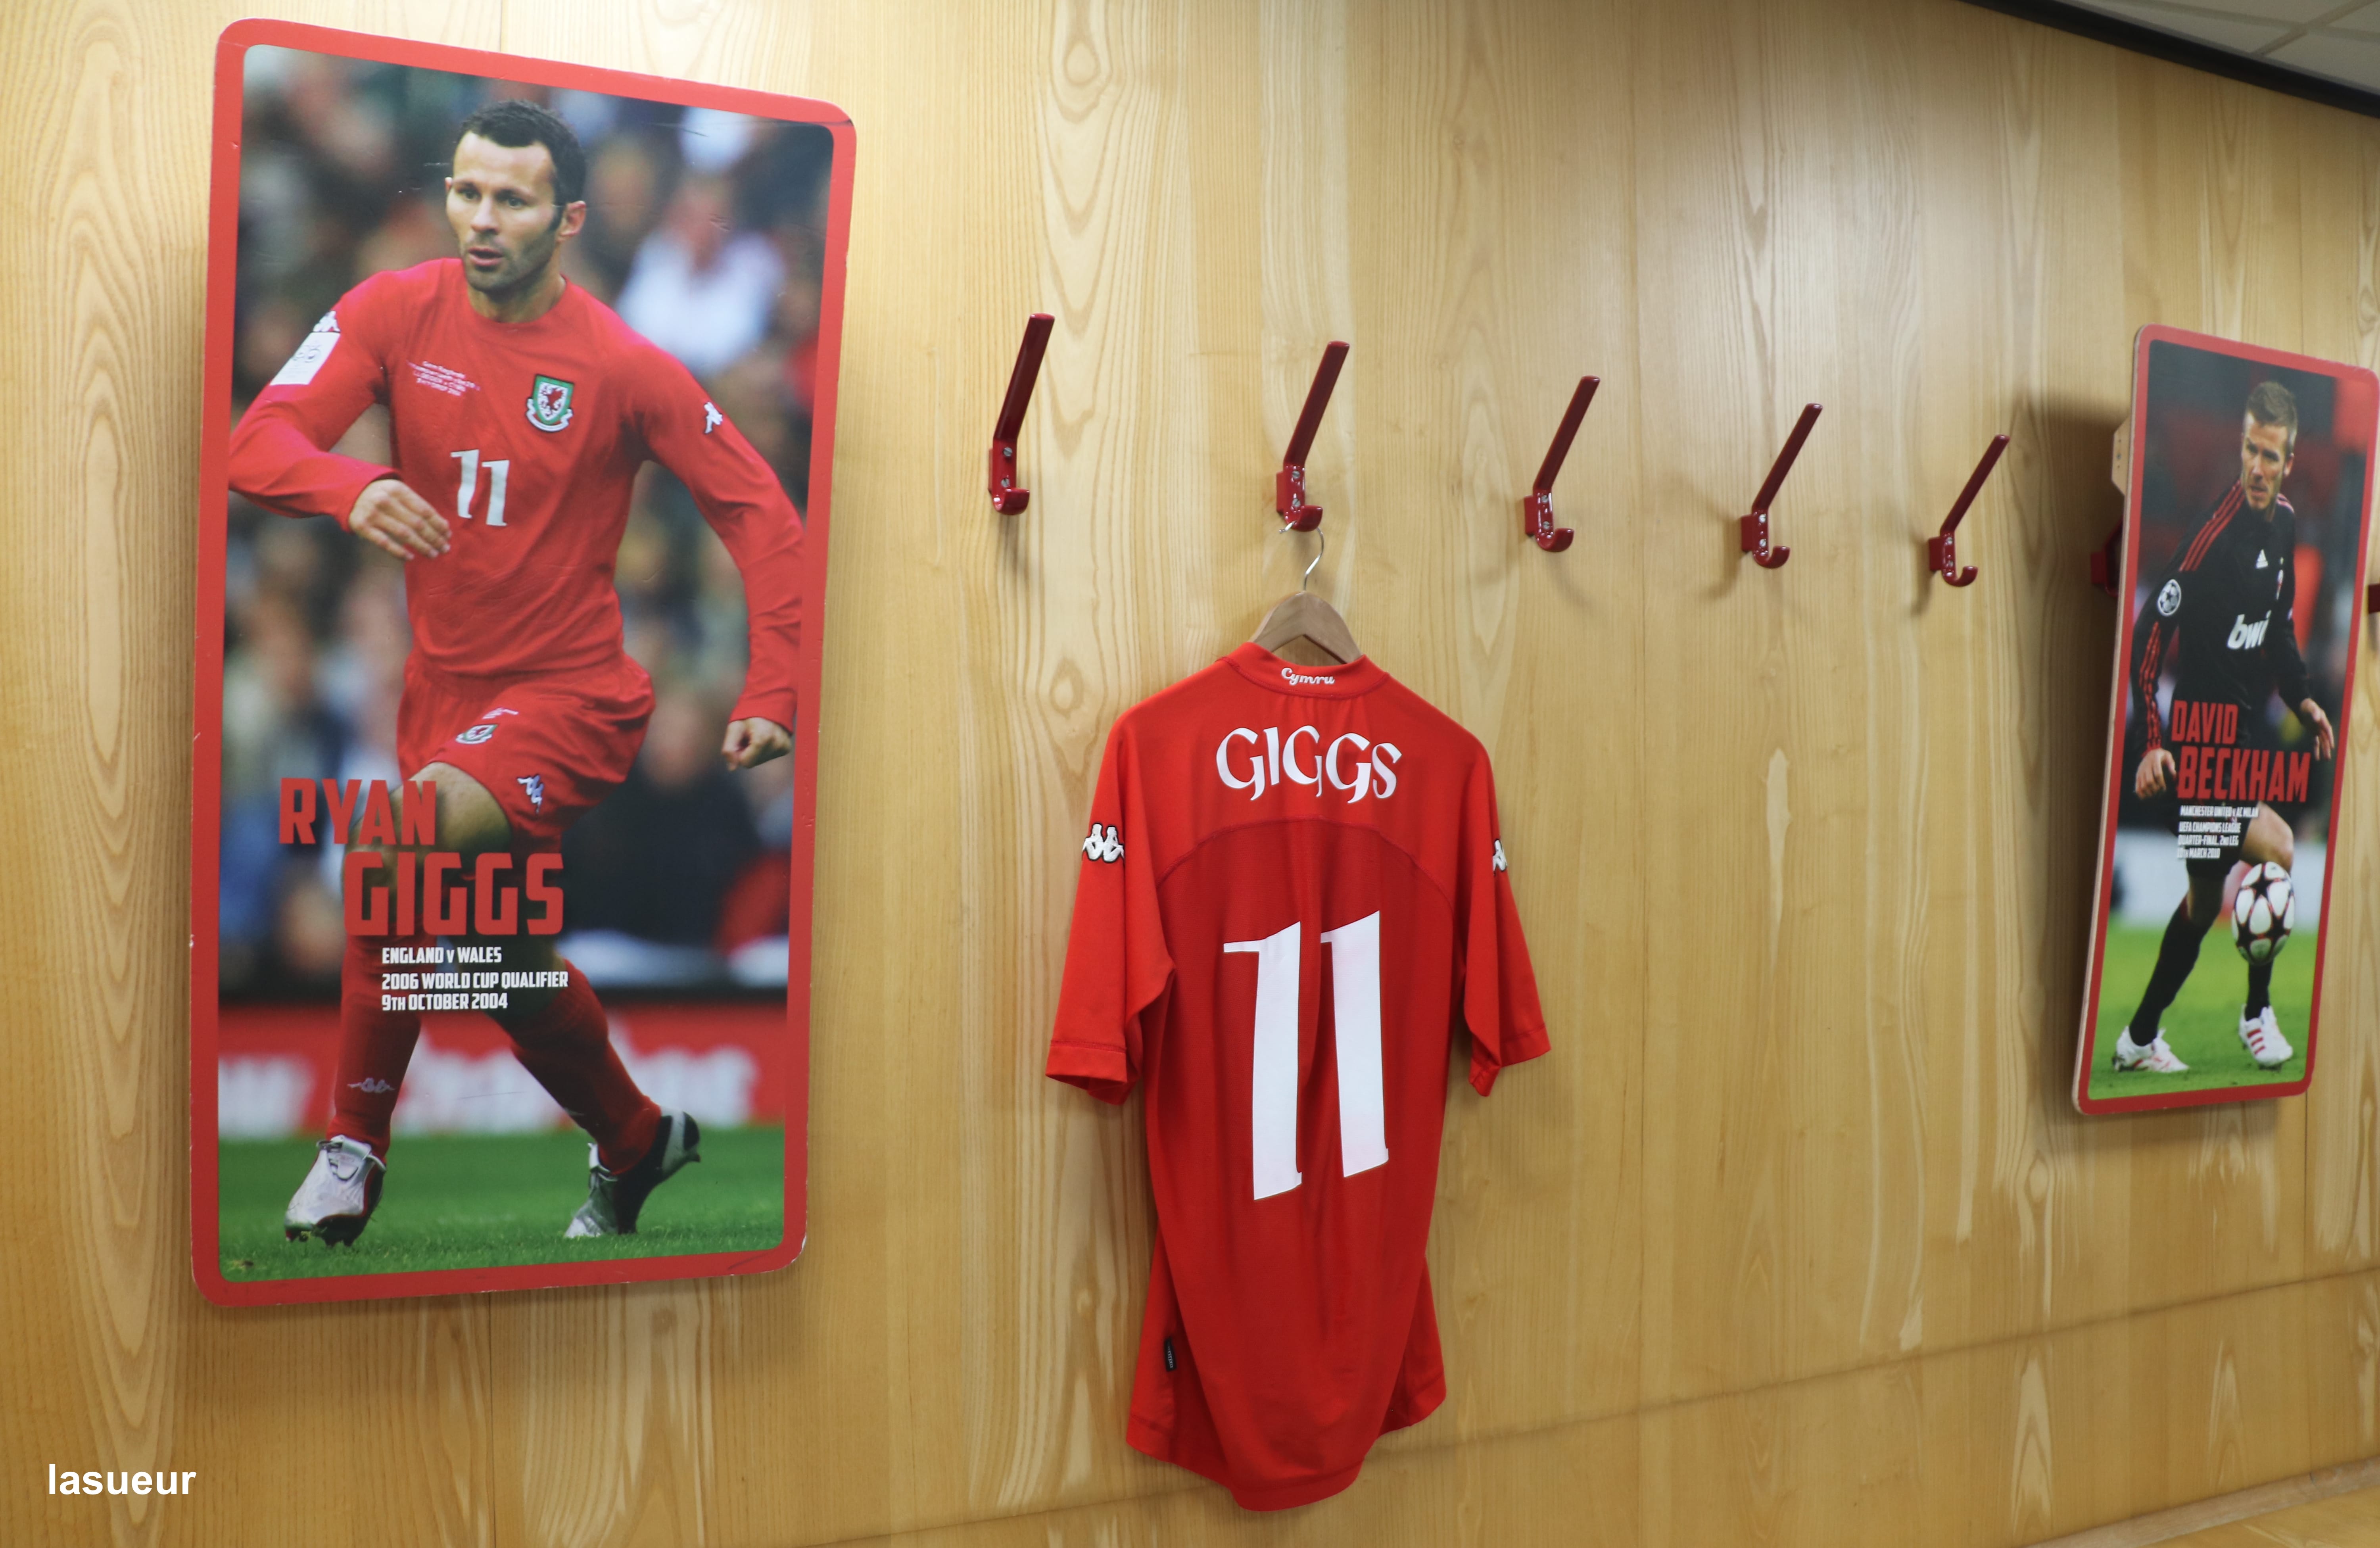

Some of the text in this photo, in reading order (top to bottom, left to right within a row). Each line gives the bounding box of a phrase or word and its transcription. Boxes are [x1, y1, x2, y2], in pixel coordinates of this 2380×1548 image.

[450, 449, 510, 526] 11
[2226, 610, 2271, 649] bwi
[1281, 667, 1335, 686] Cymru
[2171, 700, 2238, 745] DAVID
[1216, 725, 1402, 803] GIGGS
[2177, 746, 2311, 803] BECKHAM
[279, 778, 436, 846] RYAN
[2180, 805, 2213, 816] MANCHESTER
[2214, 806, 2232, 817] UNITED
[2236, 807, 2243, 817] AC
[2243, 807, 2259, 818] MILAN
[2179, 821, 2241, 833] UEFA CHAMPIONS LEAGUE
[2230, 835, 2239, 846] LEG
[2189, 848, 2207, 858] MARCH
[2207, 848, 2220, 858] 2010
[344, 852, 564, 935] GIGGS
[382, 947, 502, 964] ENGLAND v WALES
[382, 971, 568, 989] 2006 WORLD CUP QUALIFIER
[408, 993, 469, 1010] OCTOBER
[471, 993, 508, 1009] 2004
[1223, 910, 1389, 1200] 11
